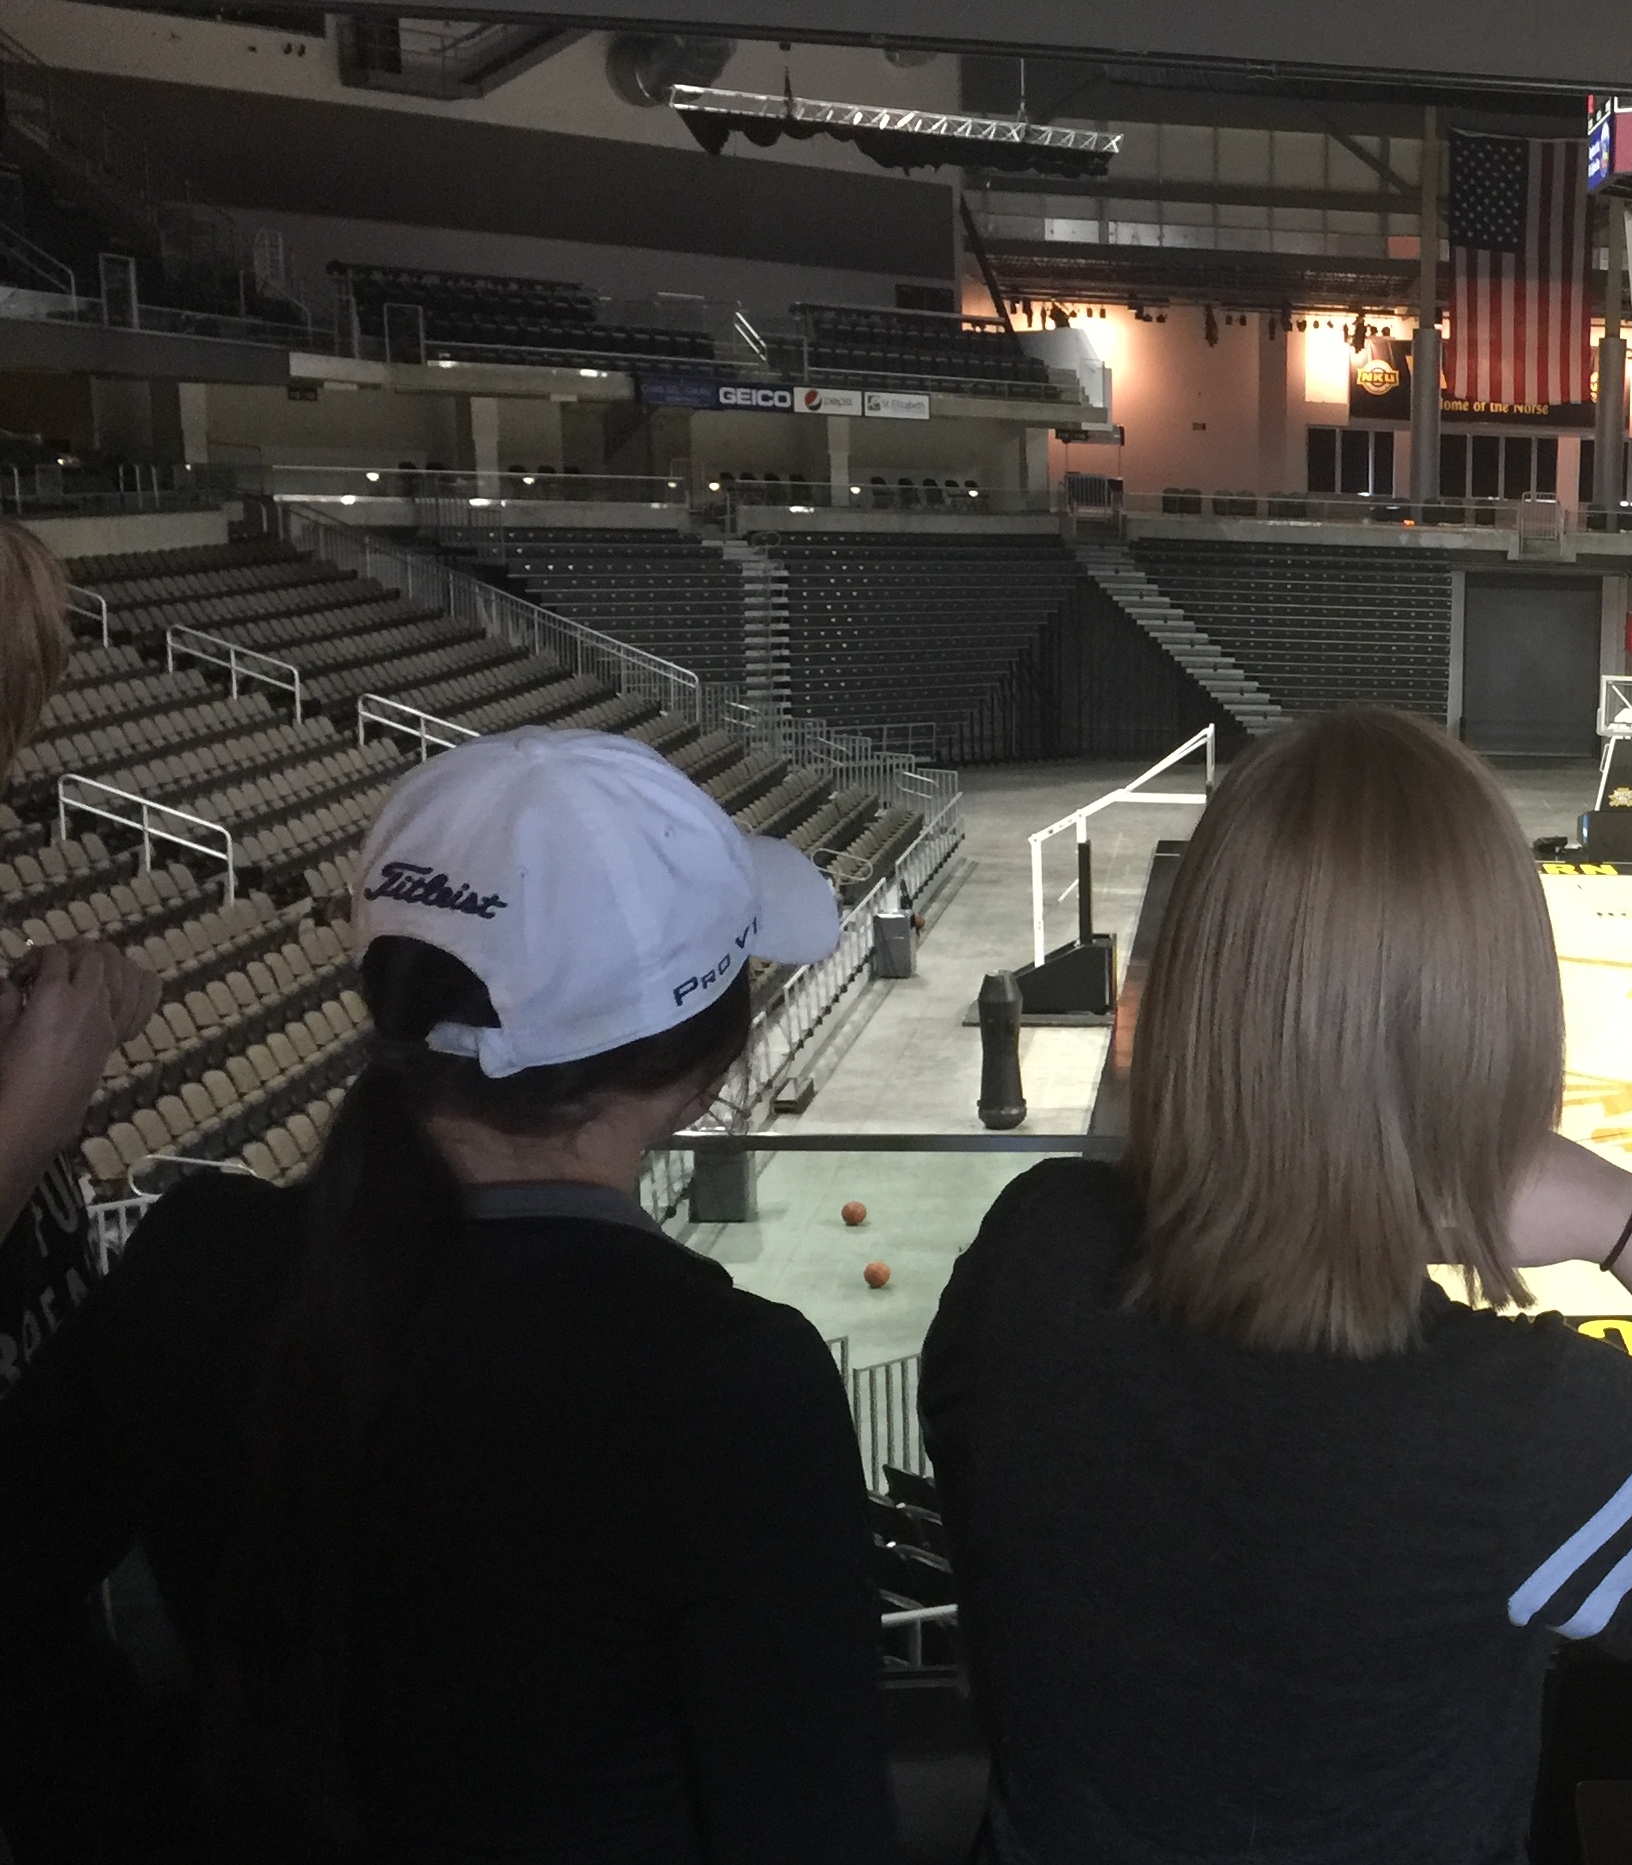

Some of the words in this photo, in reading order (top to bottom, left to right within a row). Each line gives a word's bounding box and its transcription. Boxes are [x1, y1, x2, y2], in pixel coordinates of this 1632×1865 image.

[1360, 371, 1398, 383] NKU
[719, 386, 792, 408] GEICO
[823, 395, 853, 408] pepsi
[1473, 402, 1486, 412] of
[1513, 404, 1549, 415] Norse
[364, 861, 508, 919] Titleist
